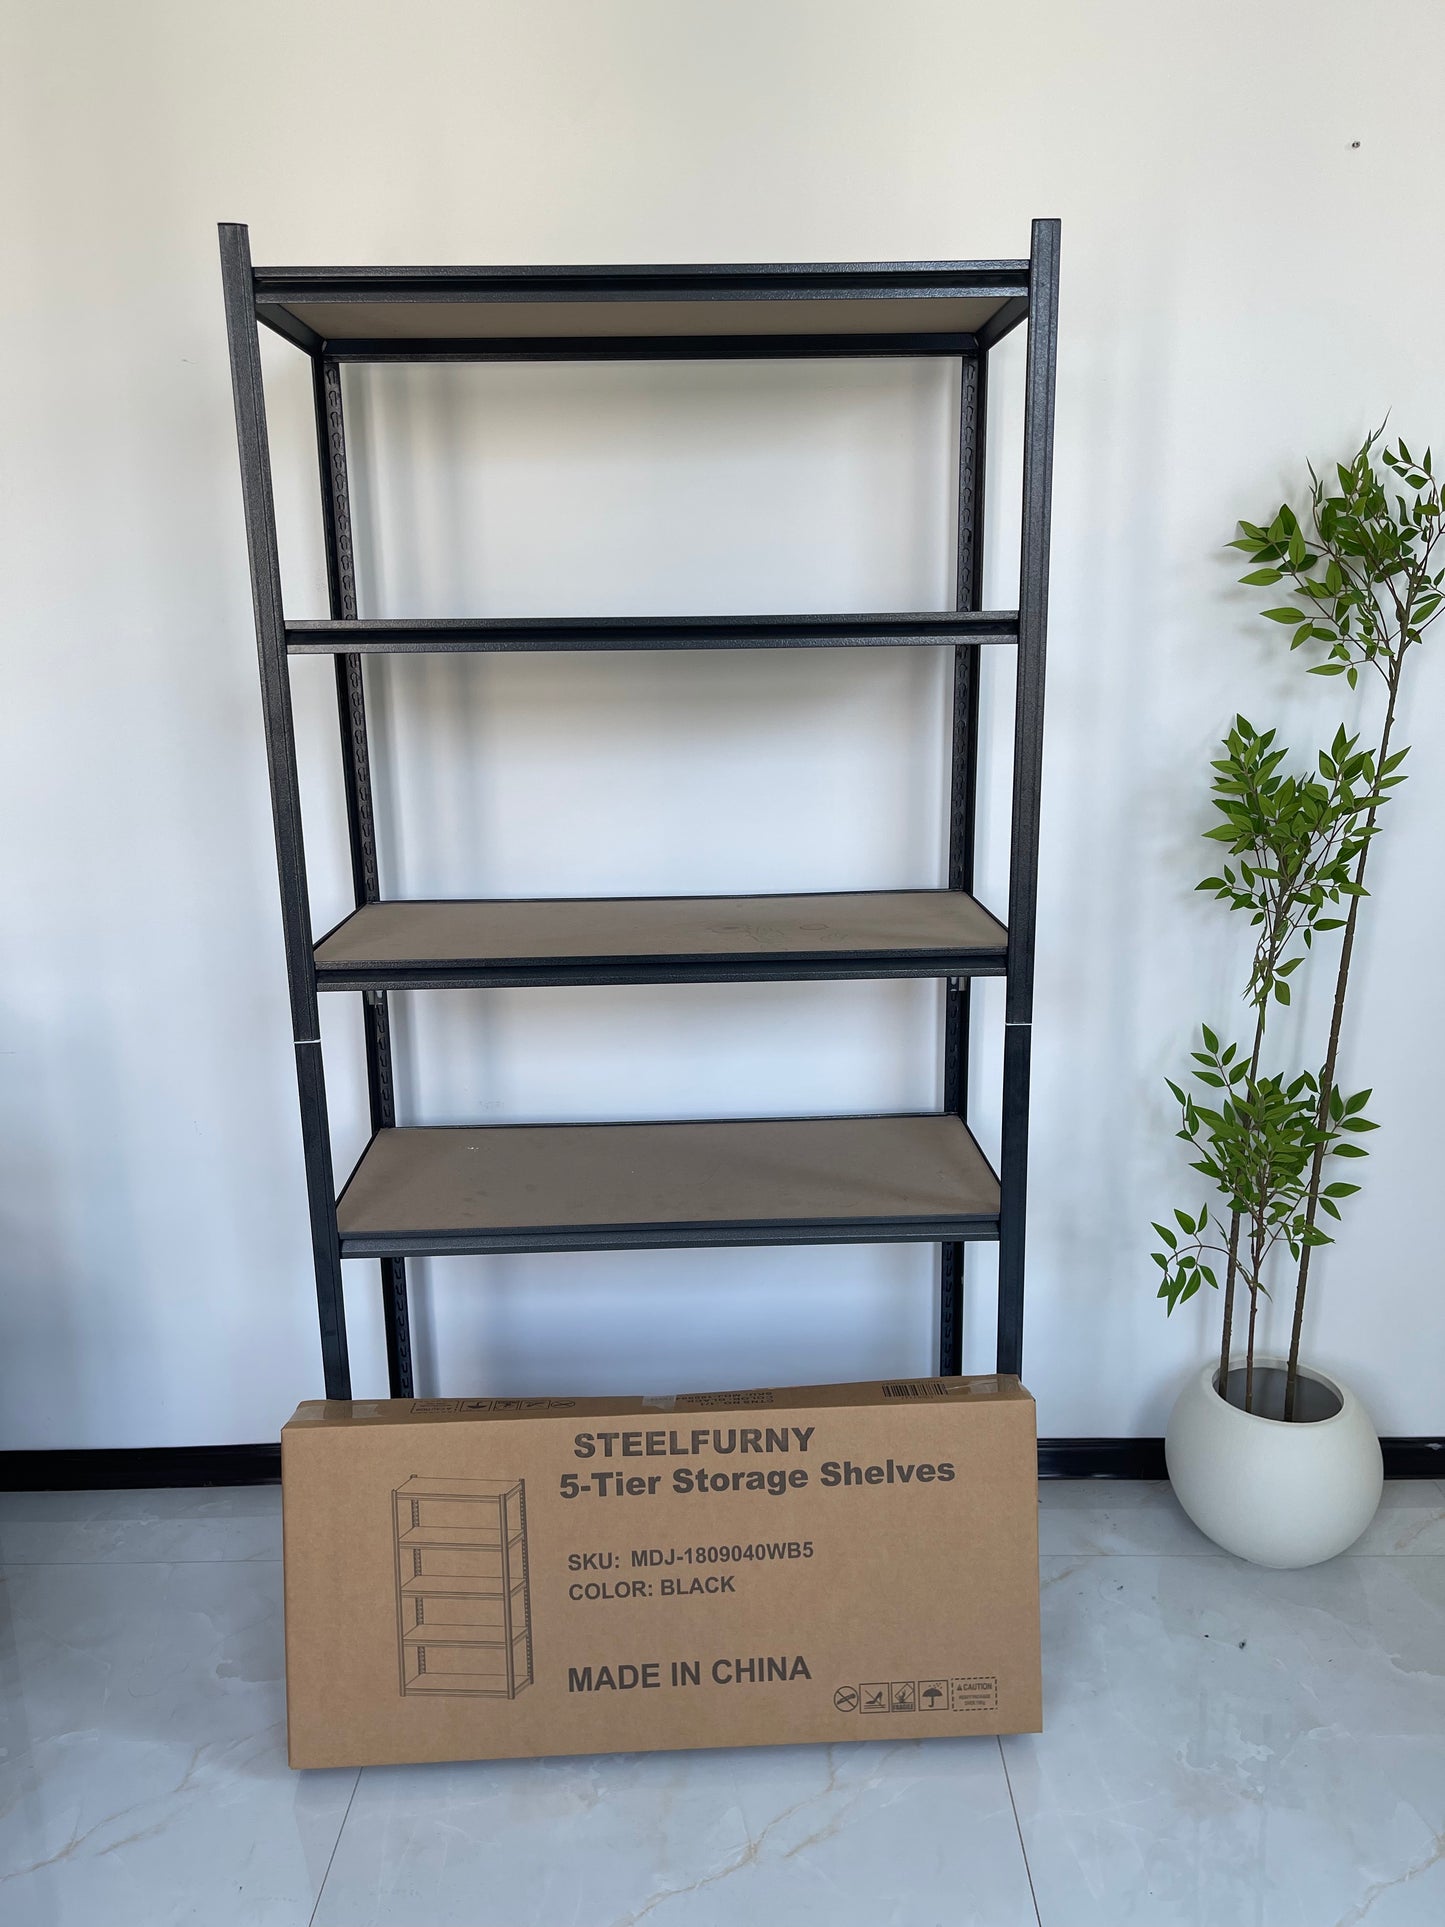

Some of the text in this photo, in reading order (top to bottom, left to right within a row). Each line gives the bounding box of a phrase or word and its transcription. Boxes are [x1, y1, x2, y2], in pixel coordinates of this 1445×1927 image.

[574, 1427, 815, 1458] STEELFURNY
[560, 1459, 956, 1498] 5-Tier Storage Shelves
[568, 1542, 814, 1571] SKU: MDJ-1809040WB5
[569, 1576, 736, 1600] COLOR: BLACK
[568, 1656, 812, 1692] MADE IN CHINA
[963, 1683, 992, 1691] CAUTION
